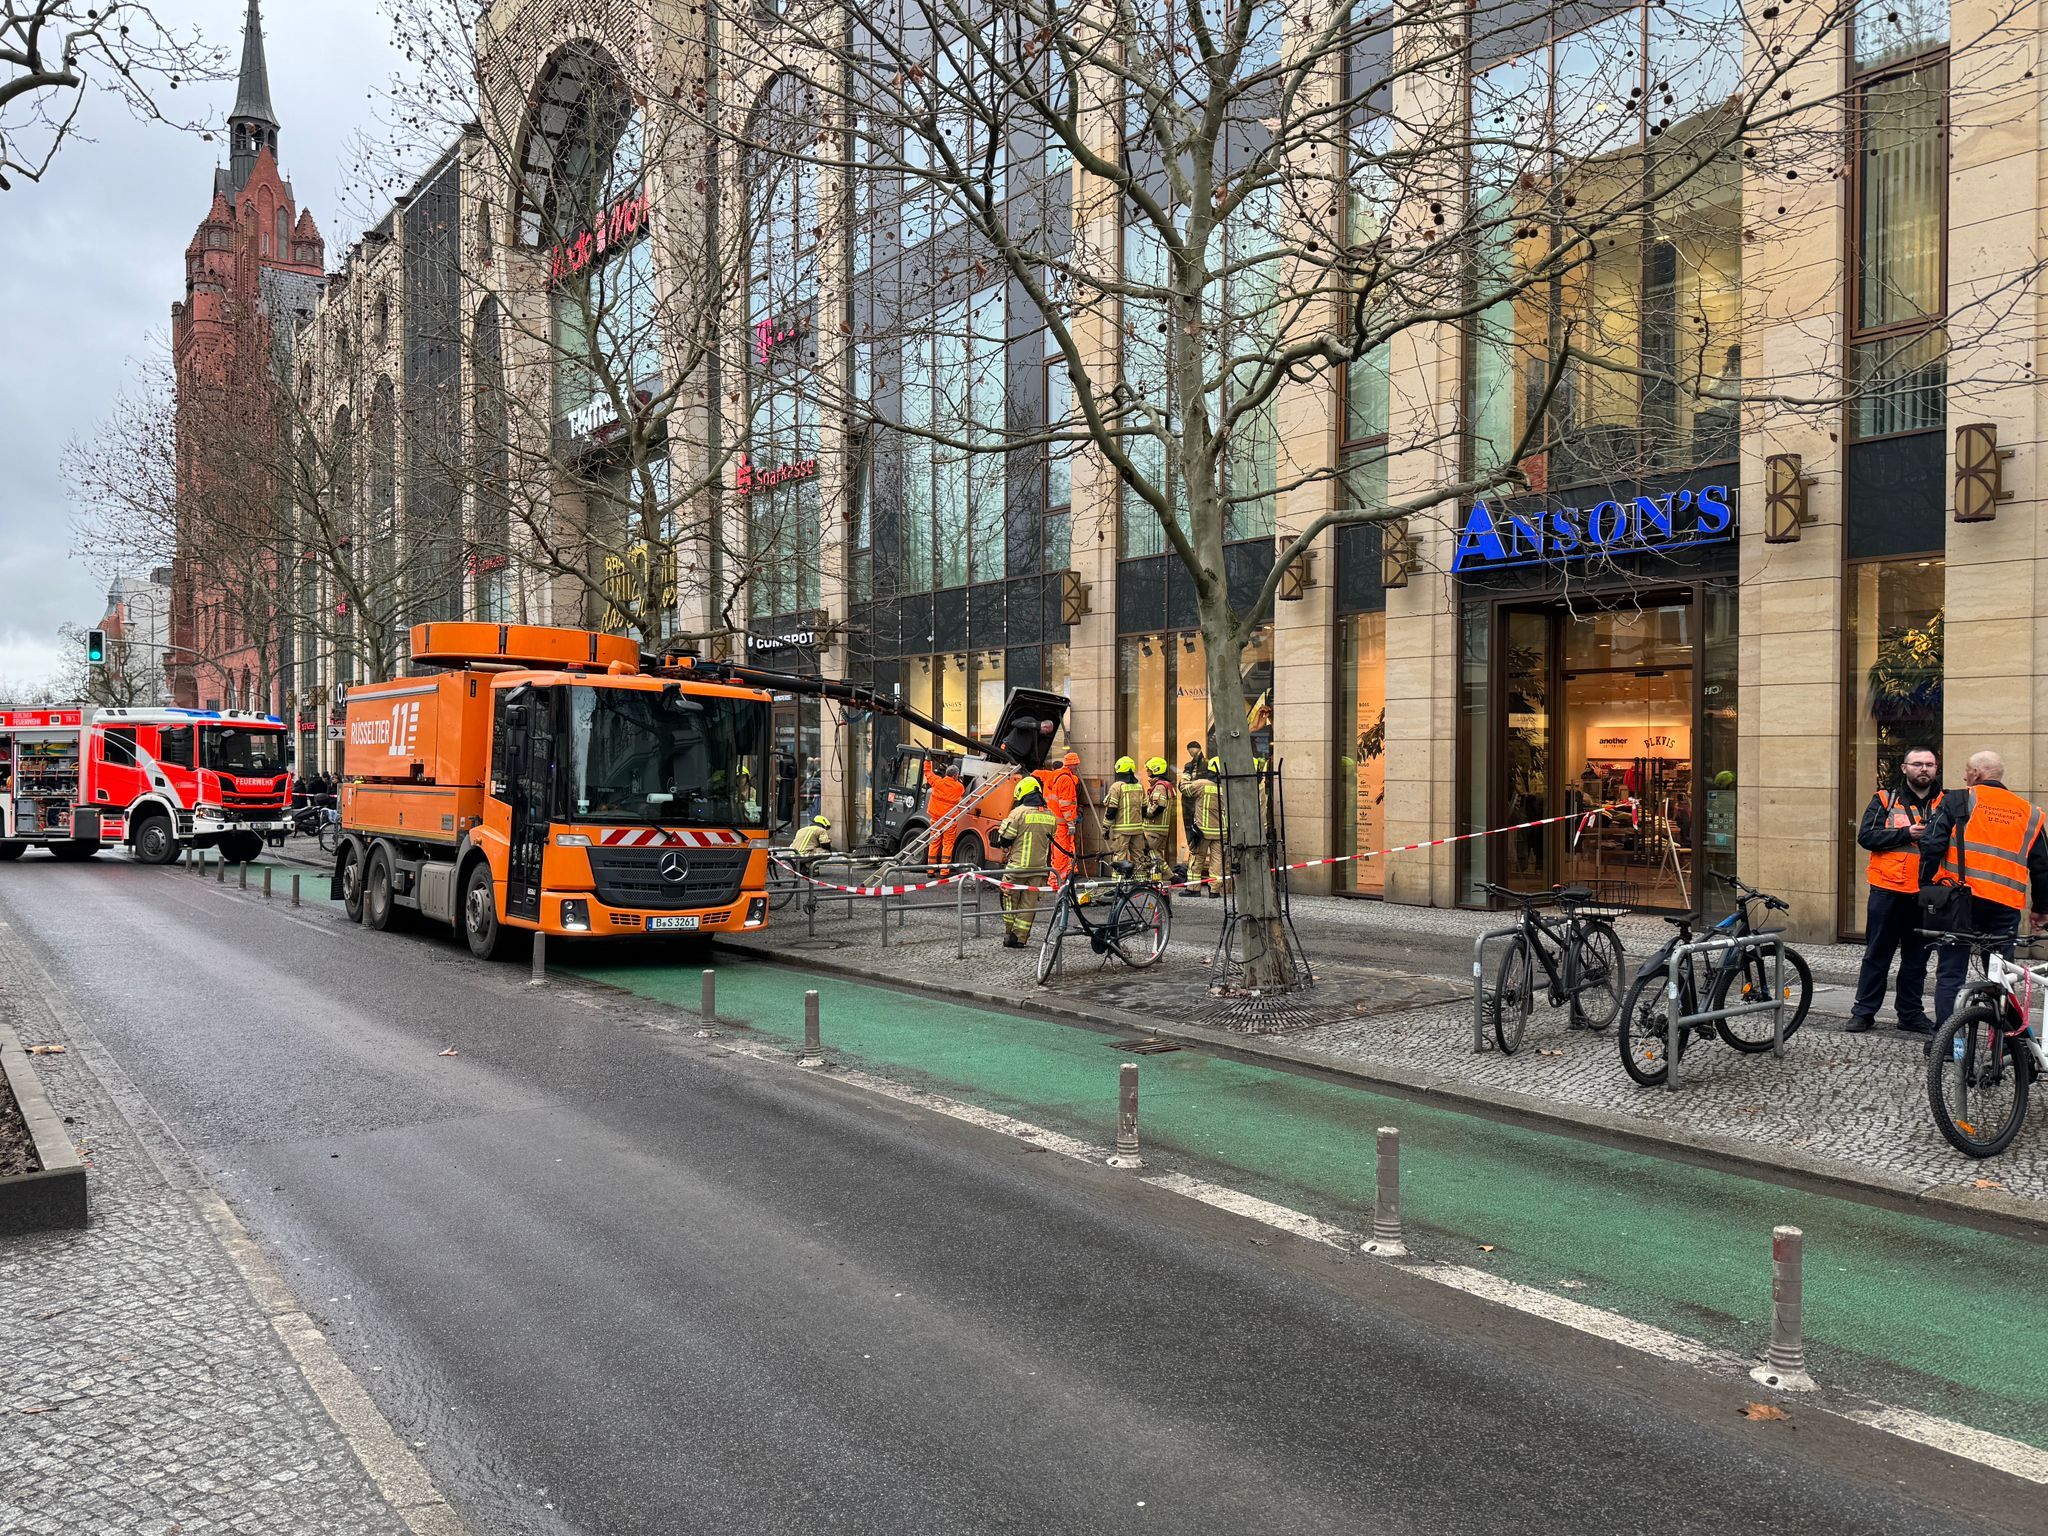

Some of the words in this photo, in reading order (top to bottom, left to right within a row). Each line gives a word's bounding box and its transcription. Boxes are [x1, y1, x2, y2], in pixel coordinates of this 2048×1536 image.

[756, 459, 814, 493] Sparkasse
[1451, 485, 1731, 573] ANSON'S
[351, 717, 390, 745] RÜSSELTIER
[389, 702, 409, 756] 11
[1599, 737, 1628, 745] another
[235, 777, 275, 787] FEUERWEHR
